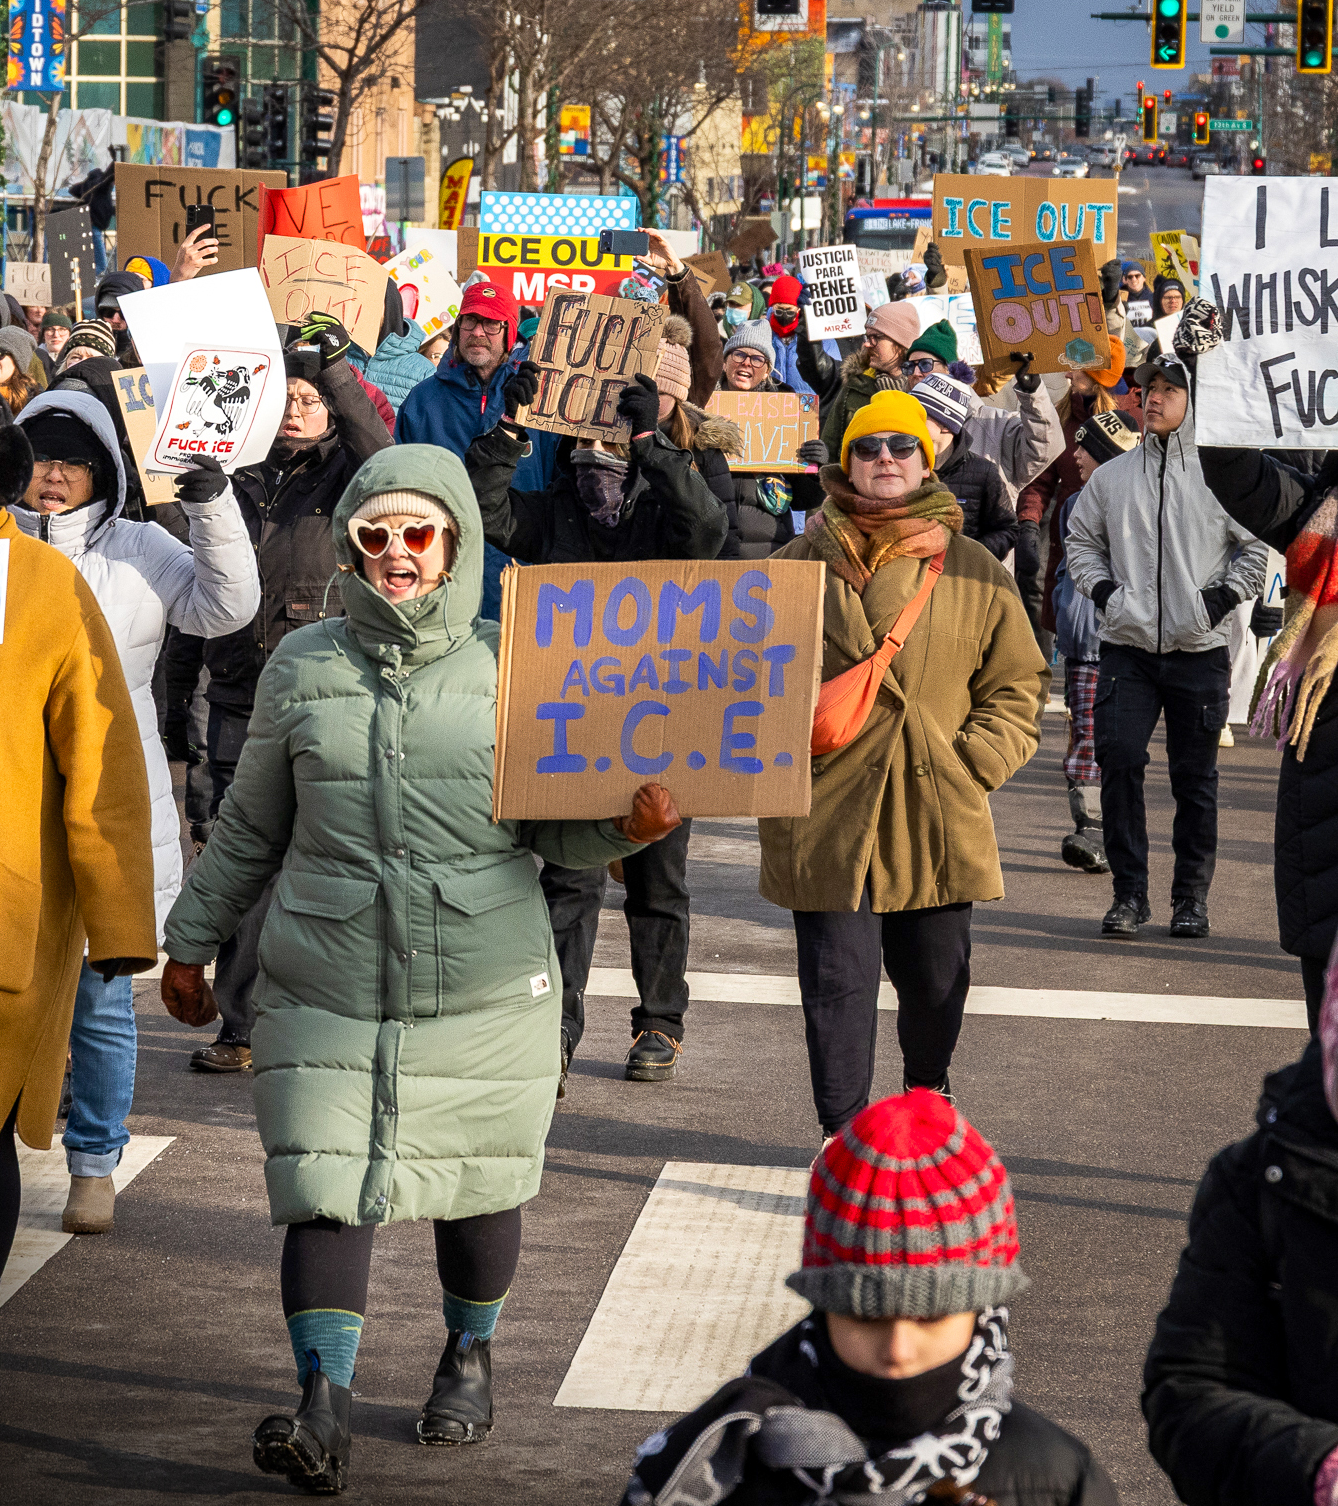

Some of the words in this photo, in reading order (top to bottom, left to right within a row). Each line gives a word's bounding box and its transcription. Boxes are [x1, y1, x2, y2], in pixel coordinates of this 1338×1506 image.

[1212, 4, 1235, 12] YIELD
[29, 0, 45, 86] IDTOWN
[145, 180, 259, 213] FUCK
[443, 175, 464, 230] MATT
[1255, 185, 1267, 250] I
[173, 222, 232, 247] IE
[942, 197, 1011, 240] ICE
[1035, 201, 1114, 244] OUT
[400, 249, 433, 272] YOUR
[482, 236, 541, 265] ICE
[803, 250, 854, 268] JUSTICIA
[816, 266, 844, 279] PARA
[982, 246, 1084, 300] ICE
[809, 277, 856, 299] RENEE
[813, 296, 858, 317] GOOD
[1211, 267, 1338, 341] WHISK
[539, 292, 652, 376] FUCK
[825, 324, 852, 333] MIRAC
[991, 292, 1103, 344] OUT!
[531, 367, 628, 428] ICE
[1261, 352, 1338, 438] FUC
[168, 438, 208, 452] FUCK
[1096, 411, 1122, 436] INS
[535, 569, 775, 649] MOMS
[560, 644, 796, 698] AGAINST
[535, 700, 793, 775] I.C.E.
